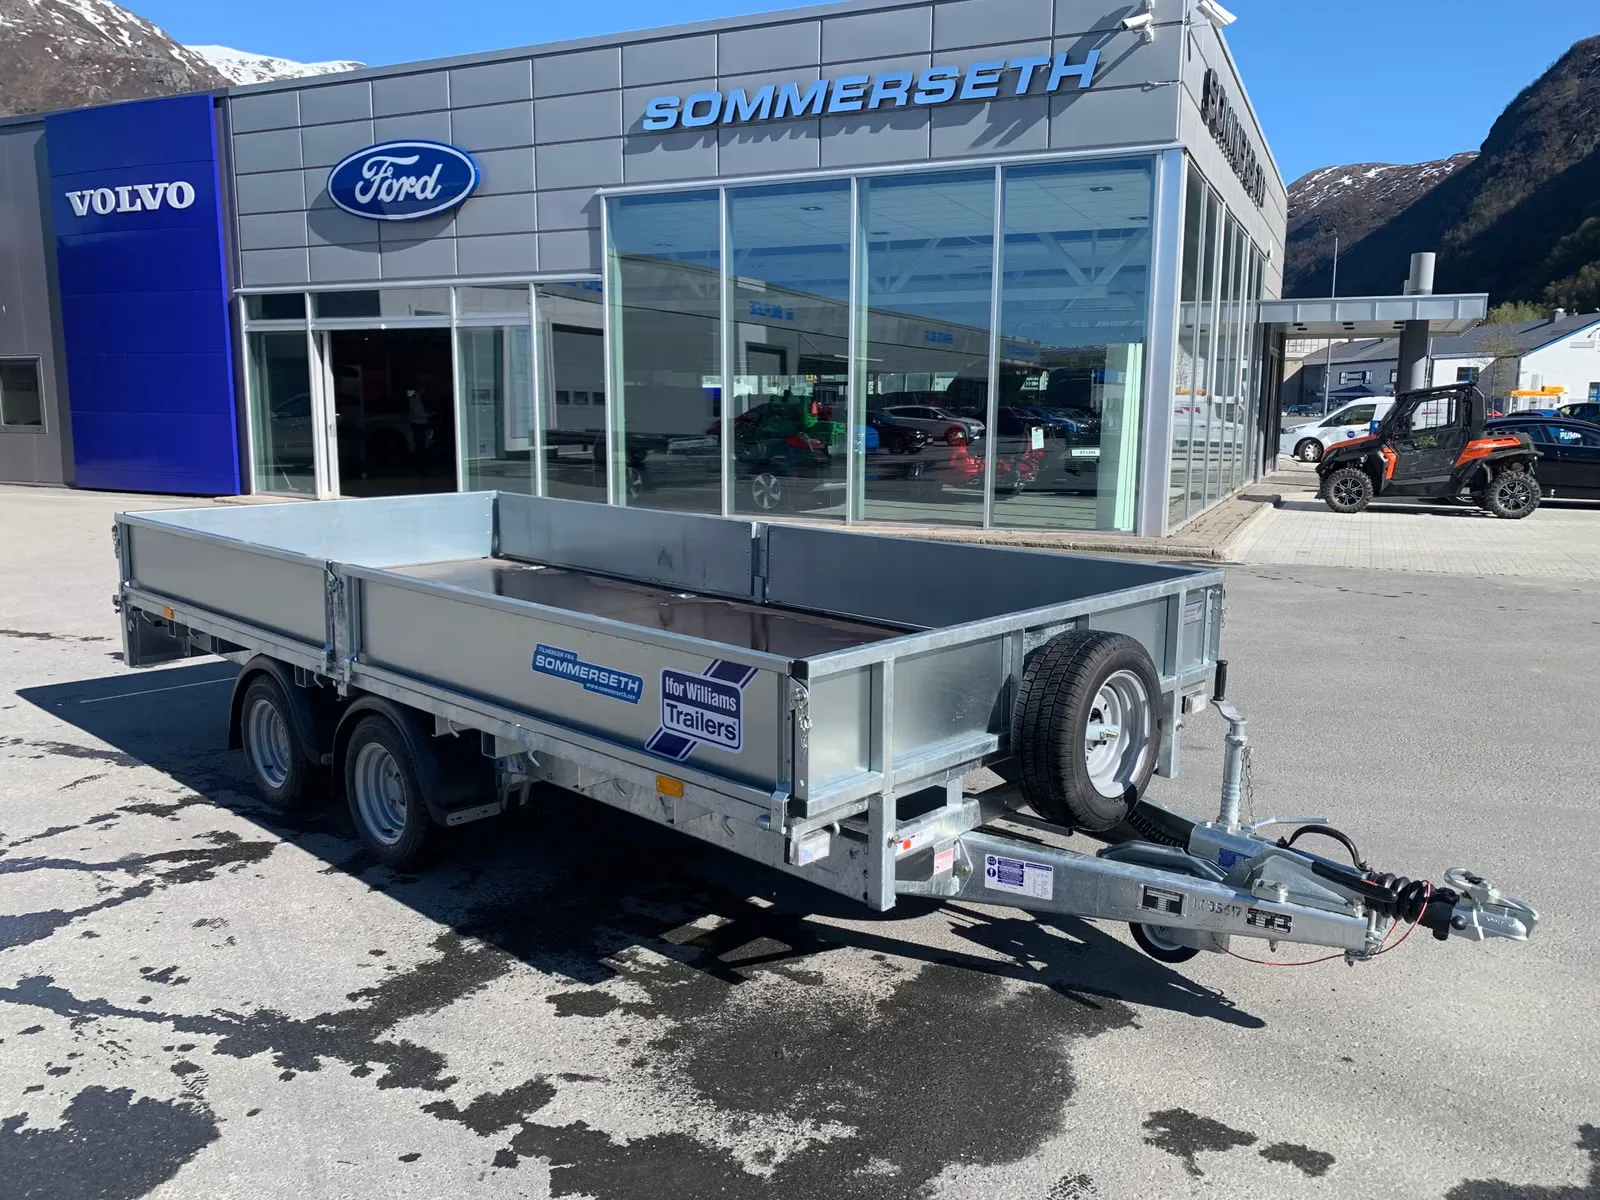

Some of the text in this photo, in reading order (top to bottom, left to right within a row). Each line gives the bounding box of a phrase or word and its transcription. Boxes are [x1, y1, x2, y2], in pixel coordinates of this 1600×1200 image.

[642, 50, 1101, 131] SOMMERSETH
[355, 154, 443, 204] Ford
[65, 180, 196, 217] VOLVO
[535, 655, 639, 692] SOMMERSETH
[564, 652, 575, 660] FRA
[665, 676, 737, 712] Ifor Williams
[665, 702, 737, 741] Trailers
